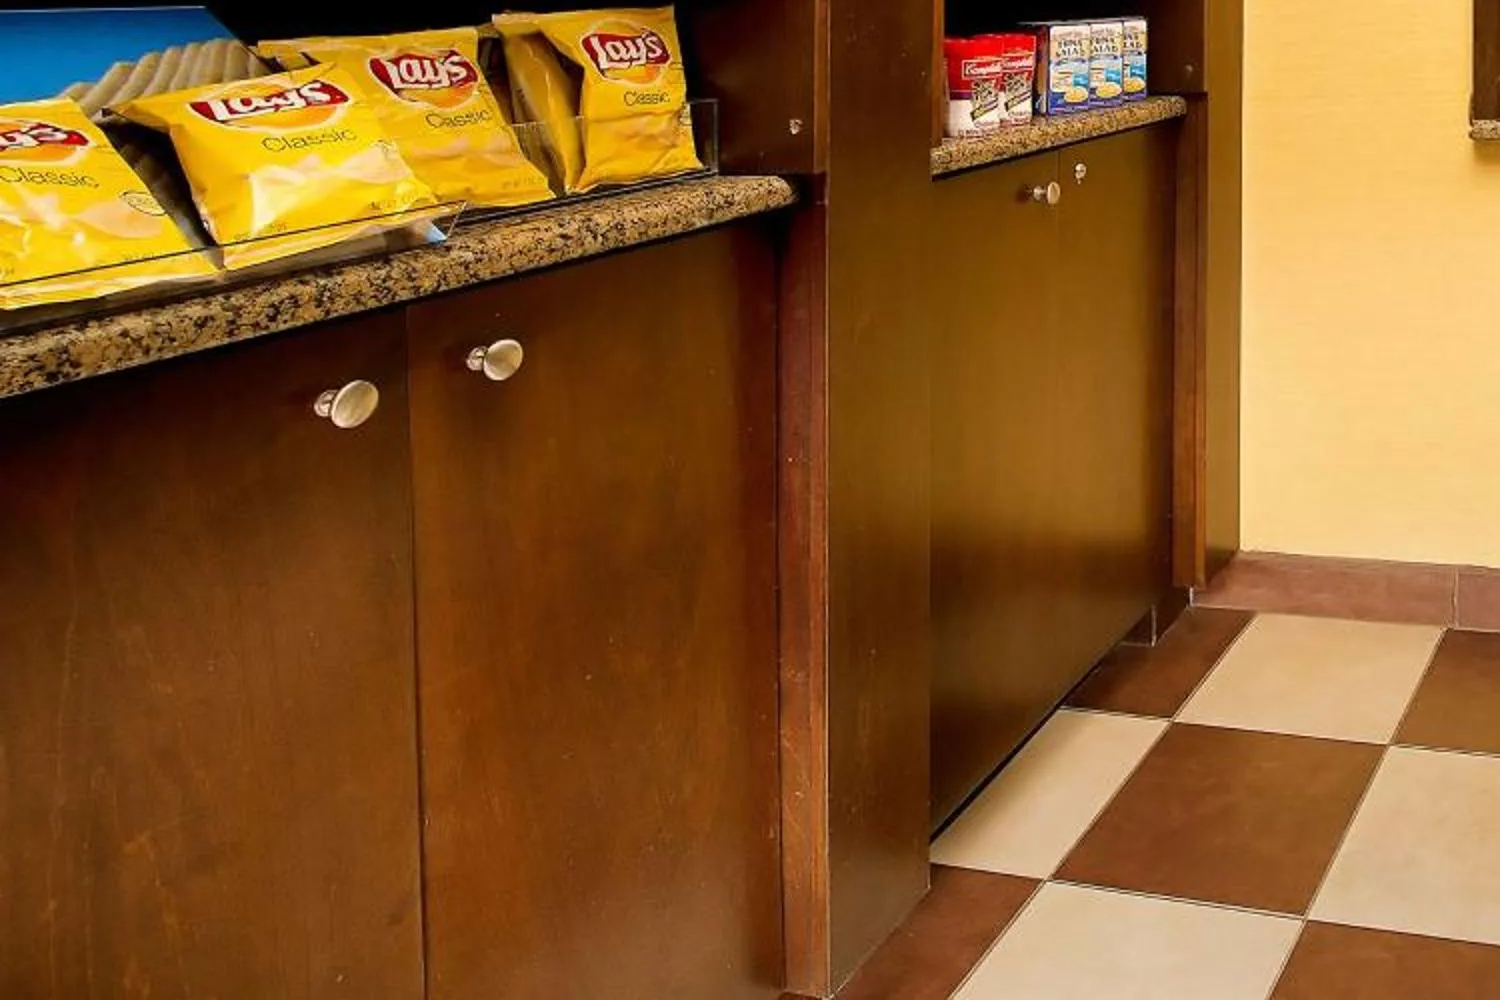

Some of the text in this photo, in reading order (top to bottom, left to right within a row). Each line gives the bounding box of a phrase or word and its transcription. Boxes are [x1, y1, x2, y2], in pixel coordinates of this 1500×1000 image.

[589, 33, 667, 70] Lay's
[385, 56, 469, 90] Lay's
[207, 80, 331, 121] Lay's
[623, 90, 671, 106] Classic
[261, 128, 357, 153] Classic
